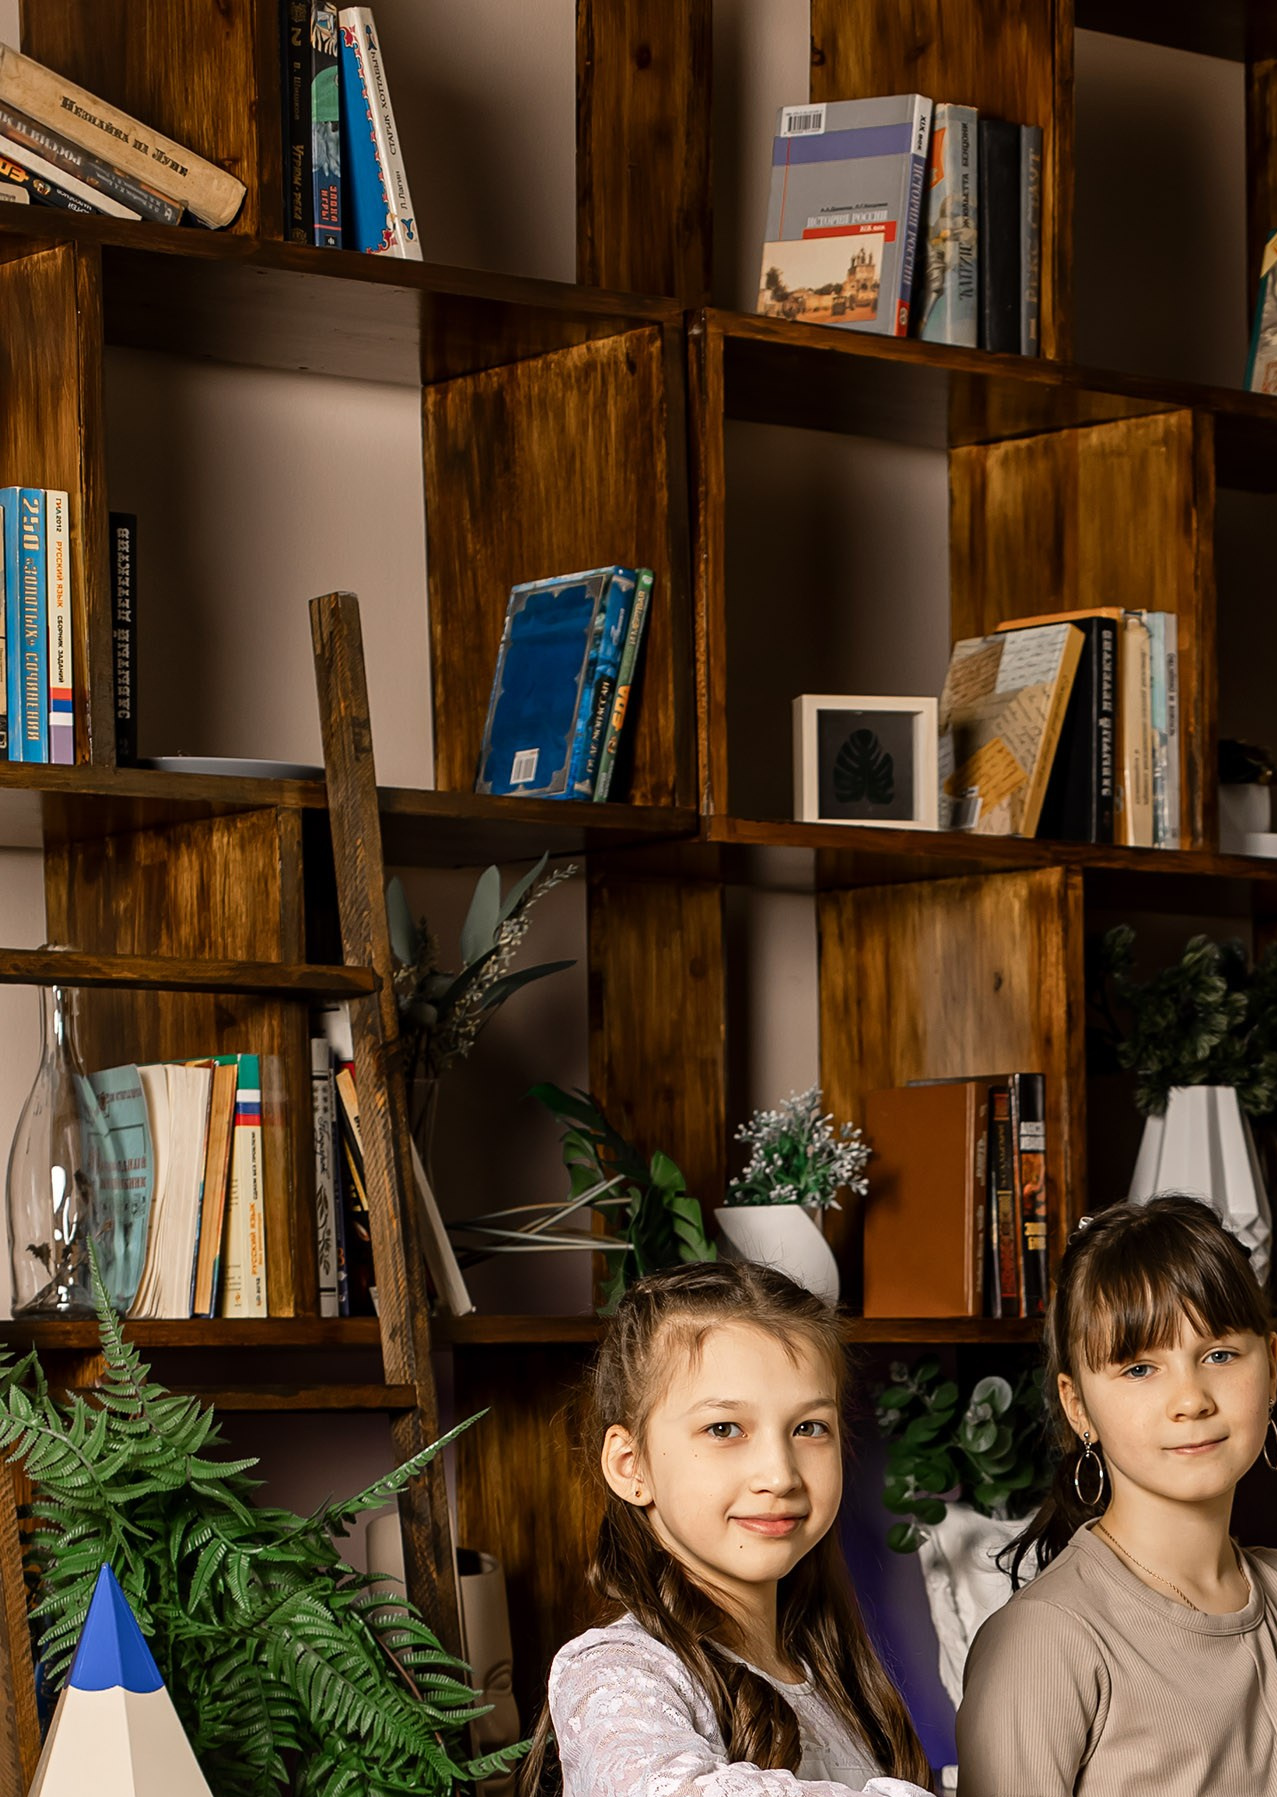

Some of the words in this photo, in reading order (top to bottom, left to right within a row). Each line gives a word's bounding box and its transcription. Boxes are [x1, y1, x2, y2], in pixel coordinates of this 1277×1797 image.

[370, 50, 388, 109] ХОТТАБЫЧ
[382, 114, 397, 156] СТАРИК
[805, 212, 850, 229] ИСТОРИЯ
[850, 208, 889, 224] РОССИИ
[22, 497, 40, 552] 250
[55, 541, 64, 582] РУССКИЙ
[117, 527, 132, 623] ДЕТЕКТИВ
[55, 583, 64, 608] ЯЗЫК
[56, 615, 64, 649] СБОРНИК
[57, 650, 65, 684] ЗАДАНИЙ
[1101, 629, 1114, 713] ДЕТЕКТИВ
